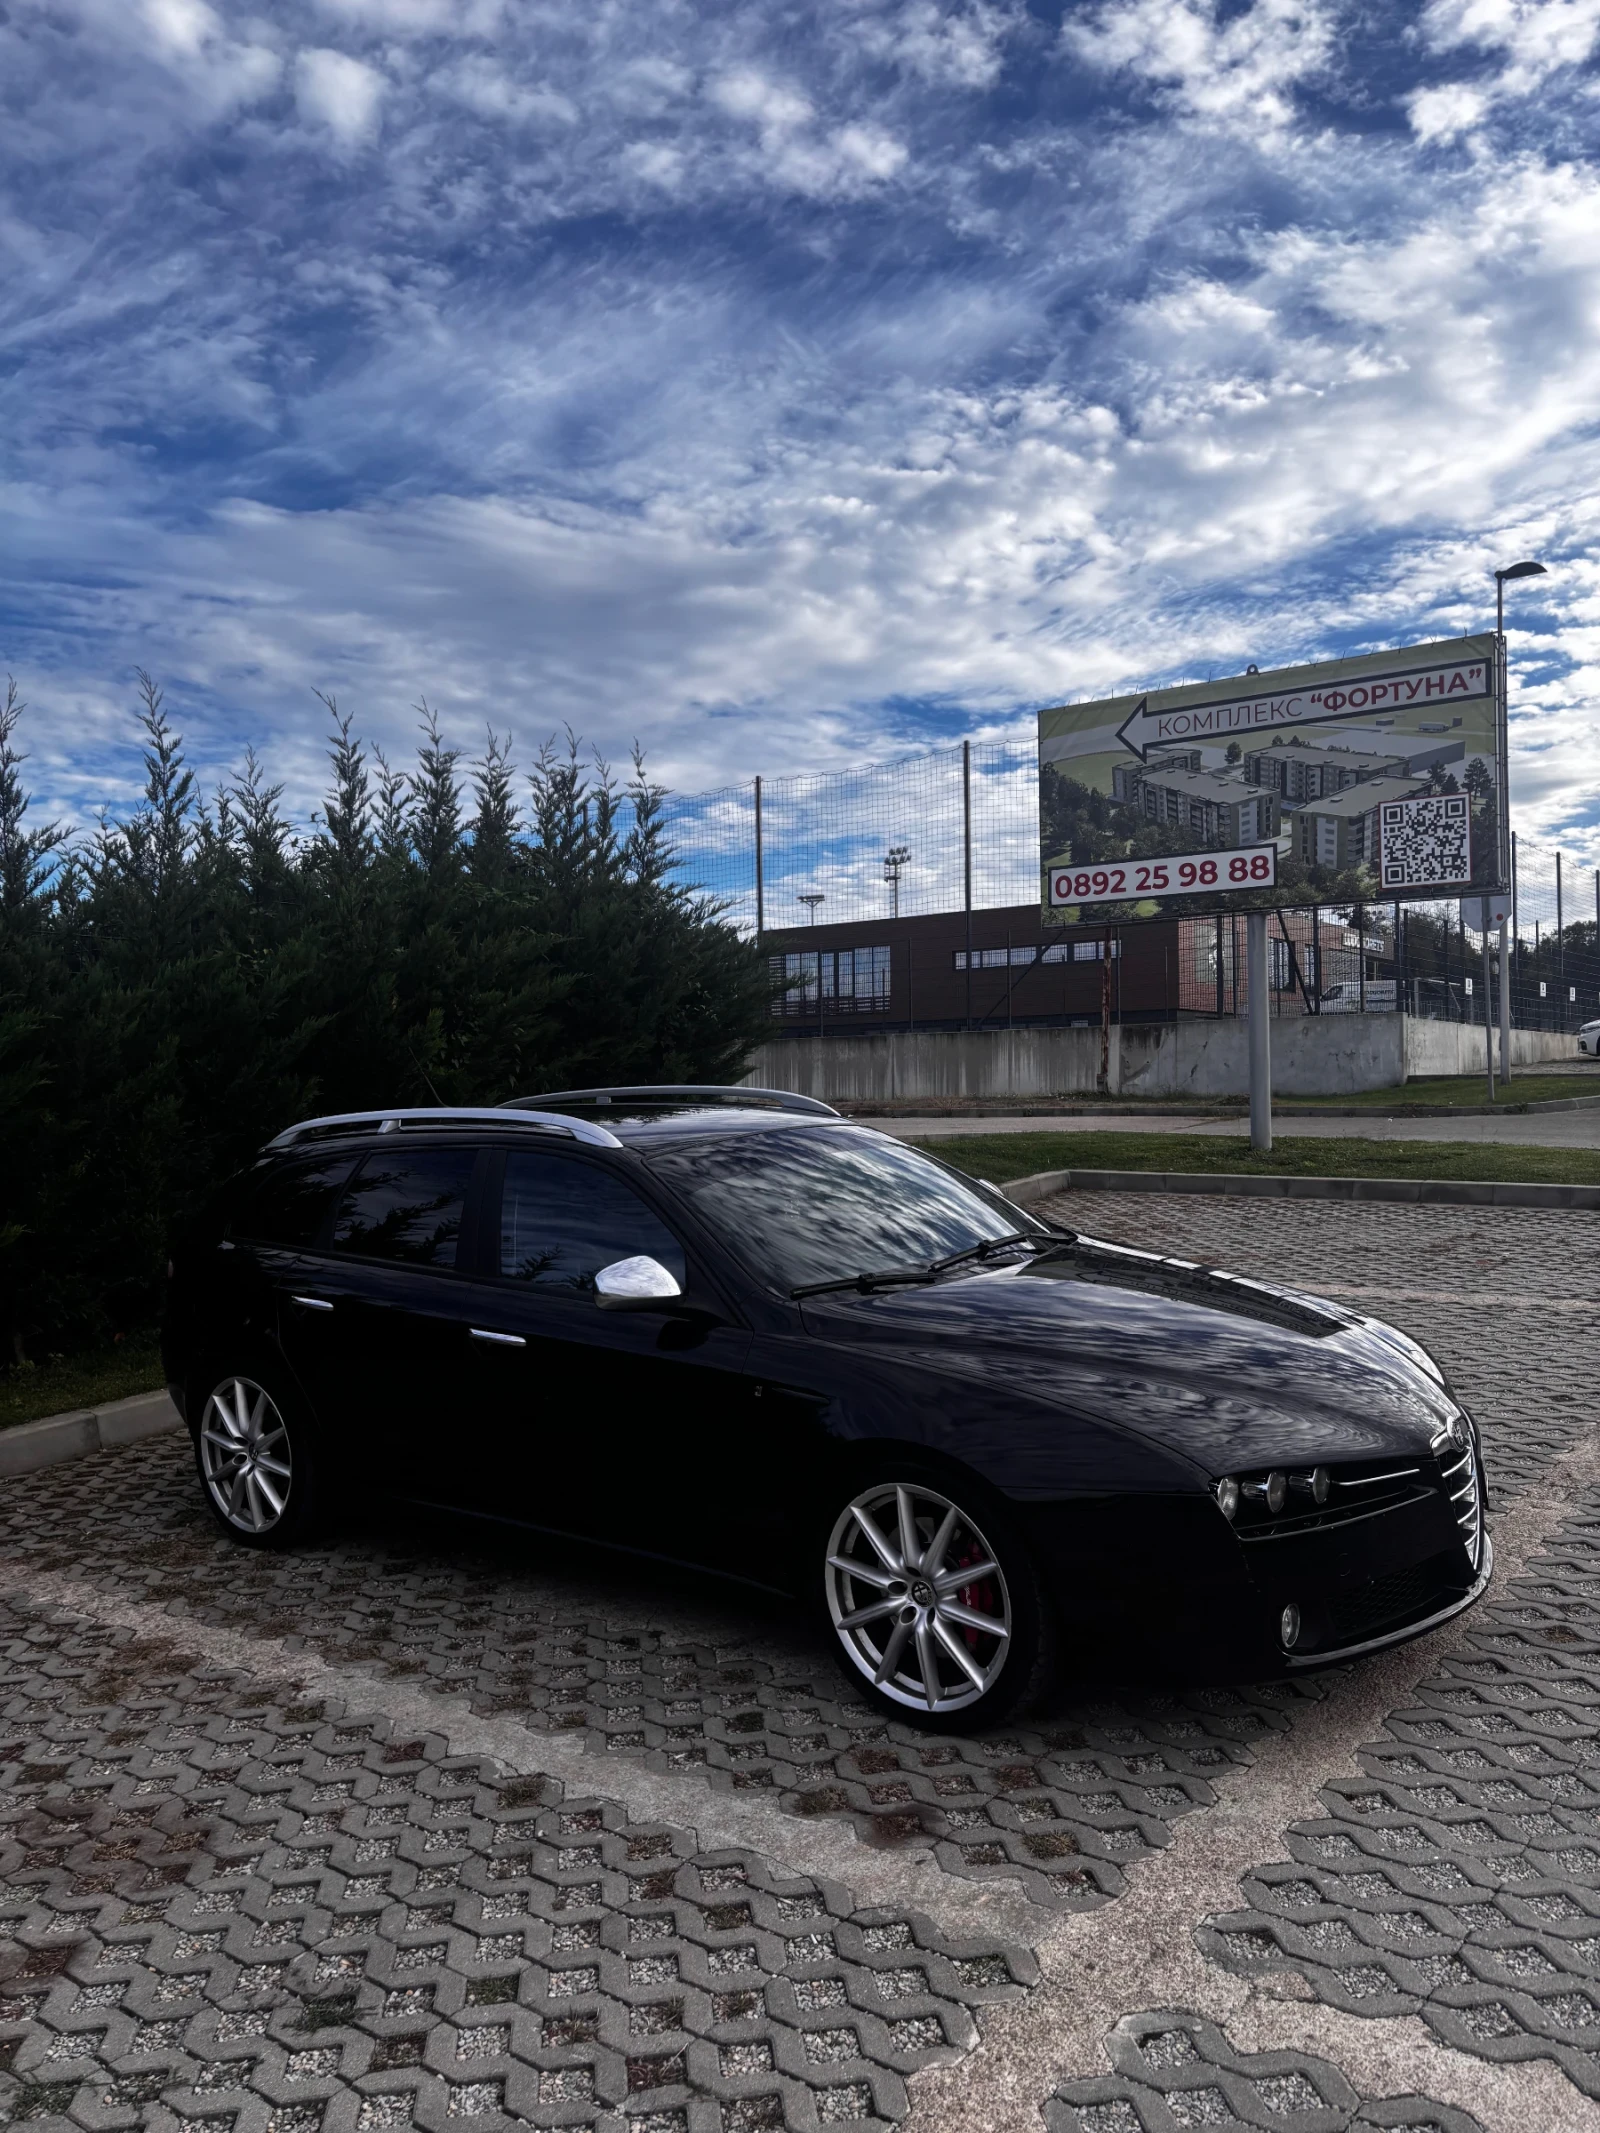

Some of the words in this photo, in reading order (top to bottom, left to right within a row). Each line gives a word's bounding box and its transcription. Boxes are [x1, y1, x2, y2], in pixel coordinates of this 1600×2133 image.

[1159, 697, 1303, 738] КОМПЛЕКС
[1055, 869, 1127, 898] 0892
[1135, 865, 1170, 891] 25
[1178, 862, 1219, 887] 98
[1228, 855, 1270, 883] 88
